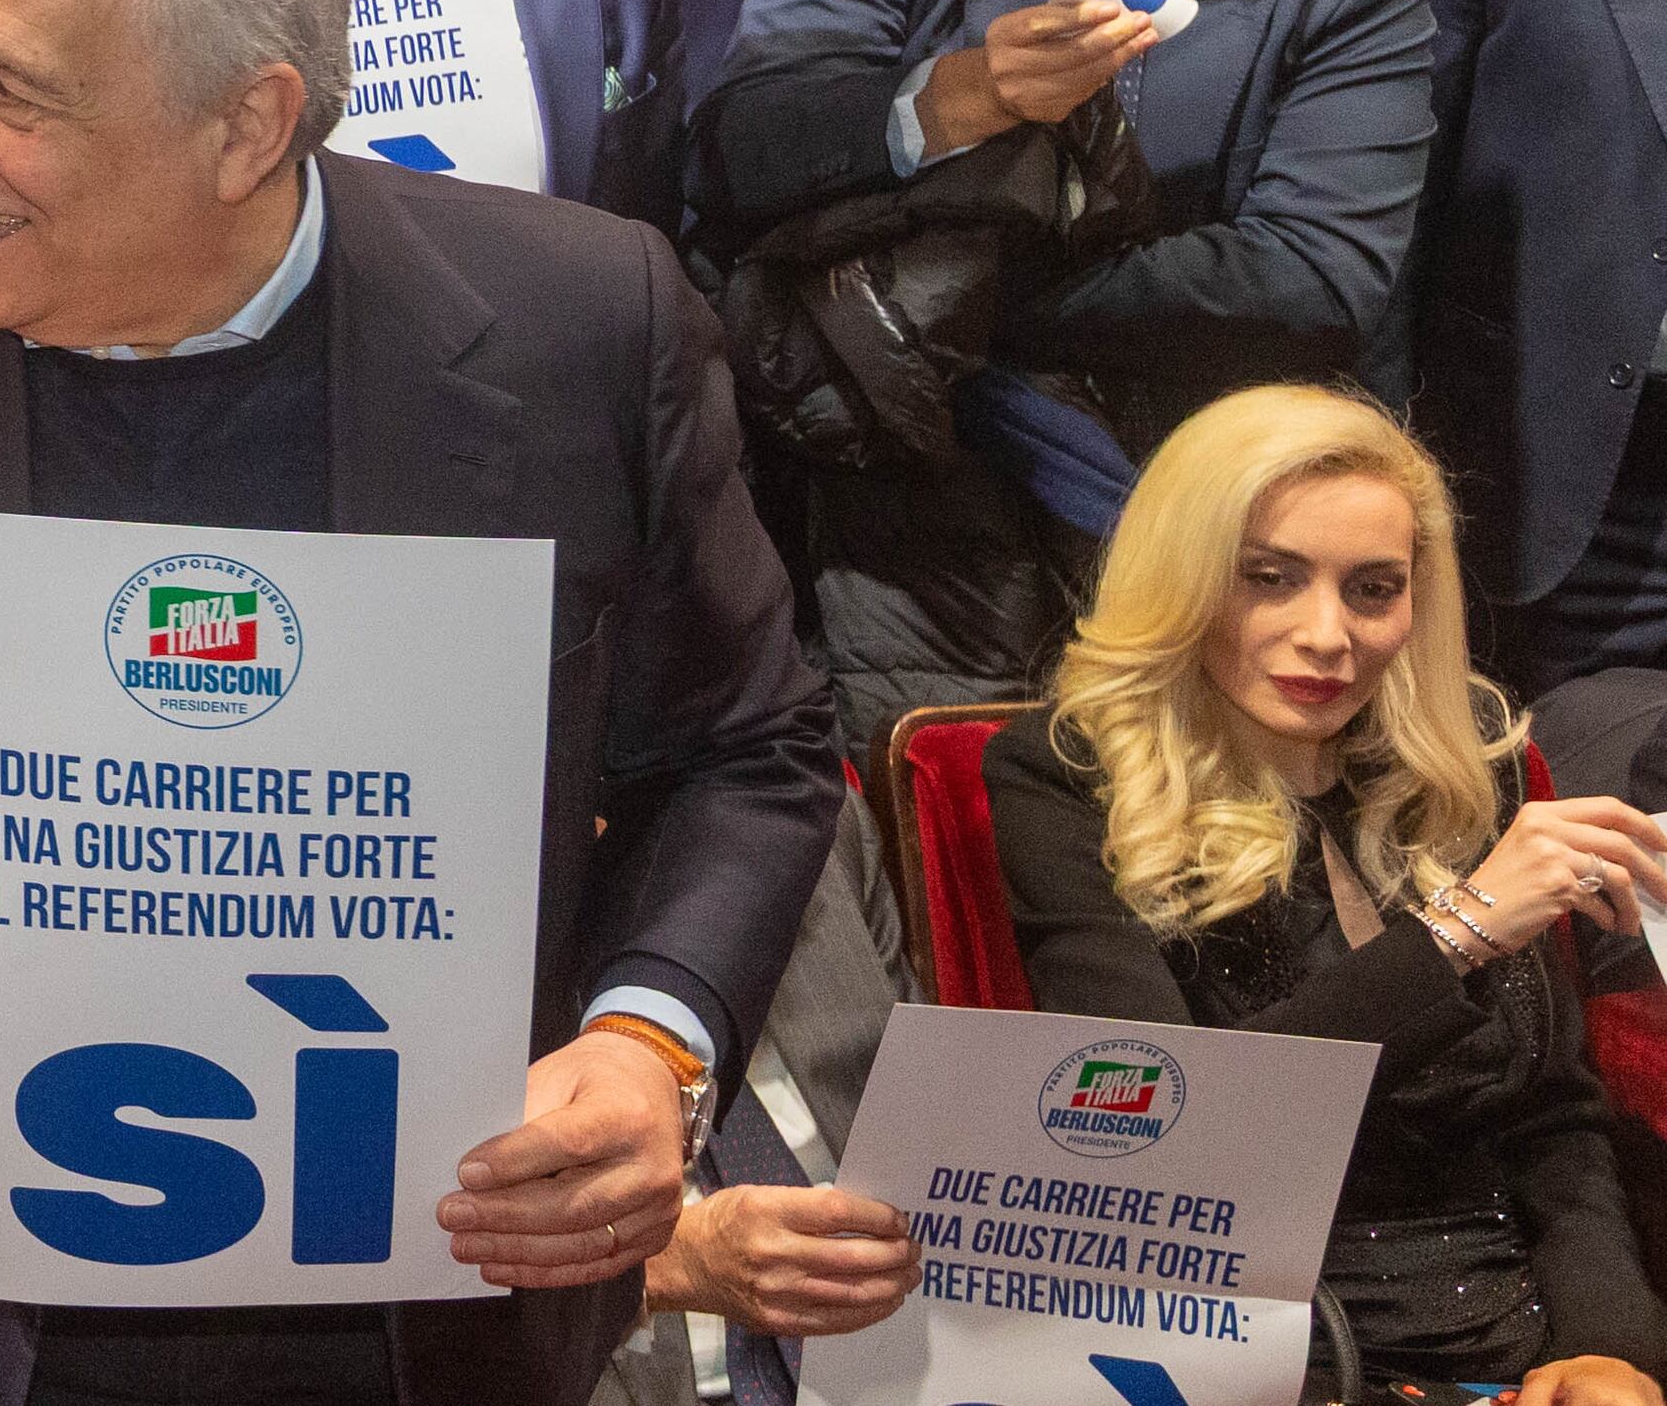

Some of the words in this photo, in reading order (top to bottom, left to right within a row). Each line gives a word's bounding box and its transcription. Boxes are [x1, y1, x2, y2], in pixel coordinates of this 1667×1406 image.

[111, 576, 149, 635] PARTITO
[154, 559, 246, 579] POPOLARE
[250, 577, 296, 646] EUROPEO
[167, 594, 236, 627] FORZA
[167, 621, 240, 655] ITALIA
[125, 659, 282, 697] BERLUSCONI
[160, 698, 248, 714] PRESIDENTE
[0, 749, 81, 802] DUE
[96, 759, 311, 815] CARRIERE
[328, 771, 410, 817] PER
[75, 822, 284, 877] GIUSTIZIA
[300, 834, 437, 879] FORTE
[24, 882, 314, 938] REFERENDUM
[330, 896, 453, 940] VOTA:
[1085, 1084, 1141, 1107] ITALIA
[1091, 1067, 1144, 1090] FORZA
[1046, 1107, 1163, 1139] BERLUSCONI
[1067, 1135, 1131, 1150] PRESIDENTE
[928, 1168, 995, 1205] DUE
[1000, 1175, 1164, 1226] CARRIERE
[1168, 1194, 1235, 1236] PER
[972, 1219, 1127, 1271] GIUSTIZIA
[1137, 1239, 1245, 1288] FORTE
[923, 1261, 1145, 1327] REFERENDUM
[1157, 1291, 1249, 1342] VOTA:
